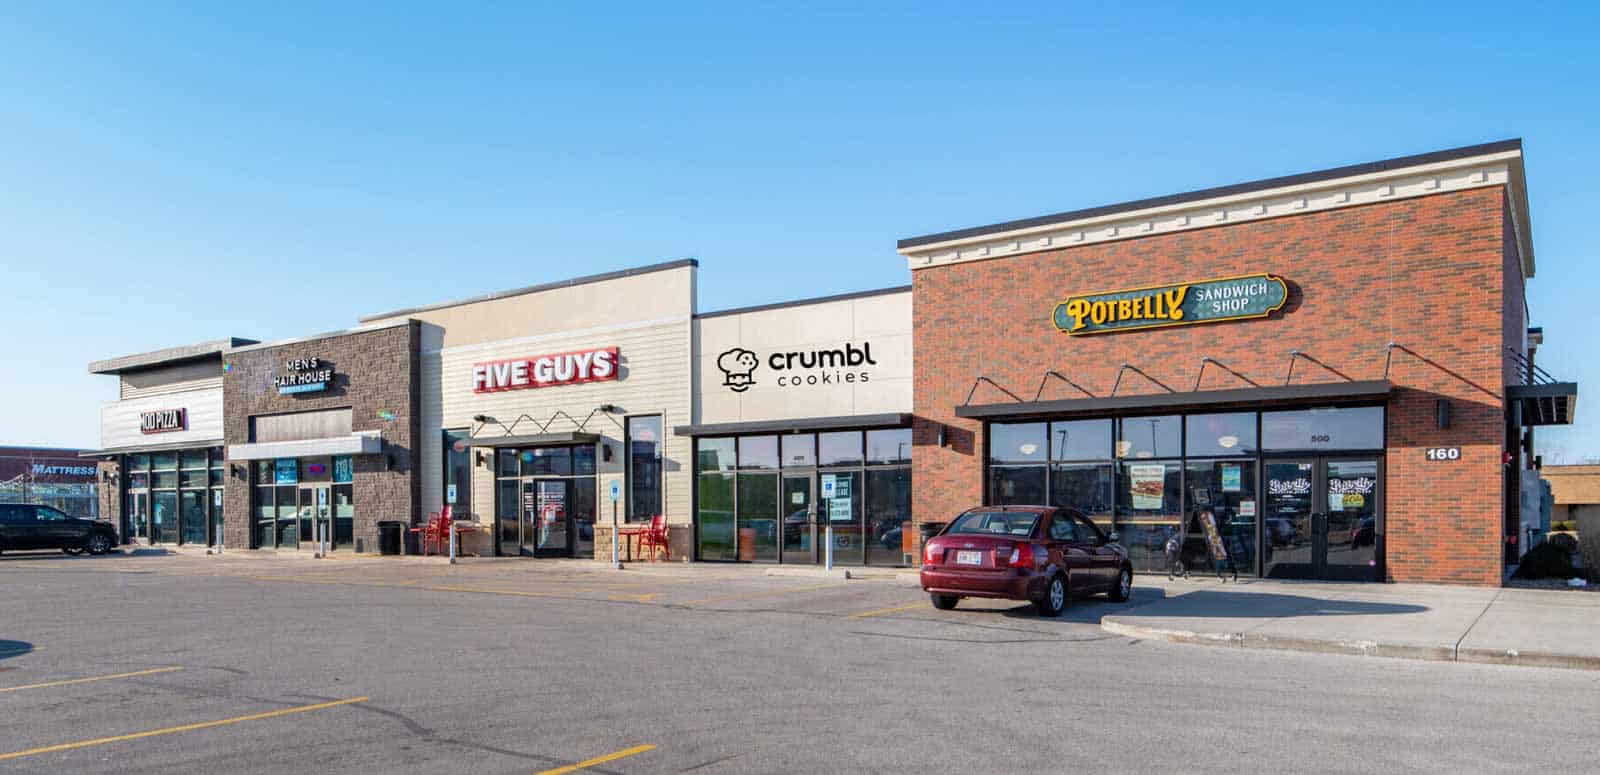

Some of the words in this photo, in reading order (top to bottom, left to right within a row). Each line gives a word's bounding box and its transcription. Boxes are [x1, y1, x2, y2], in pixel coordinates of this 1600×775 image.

[1196, 283, 1268, 301] SANDWICH
[1066, 285, 1190, 330] POTBELLY
[1212, 298, 1249, 312] SHOP
[768, 342, 877, 370] crumbl
[273, 375, 296, 387] HAIR
[298, 370, 331, 384] HOUSE
[472, 360, 529, 390] FIVE
[533, 350, 612, 383] GUYS
[777, 371, 870, 387] cookies
[156, 409, 178, 429] PIZZA
[1427, 448, 1459, 460] 160
